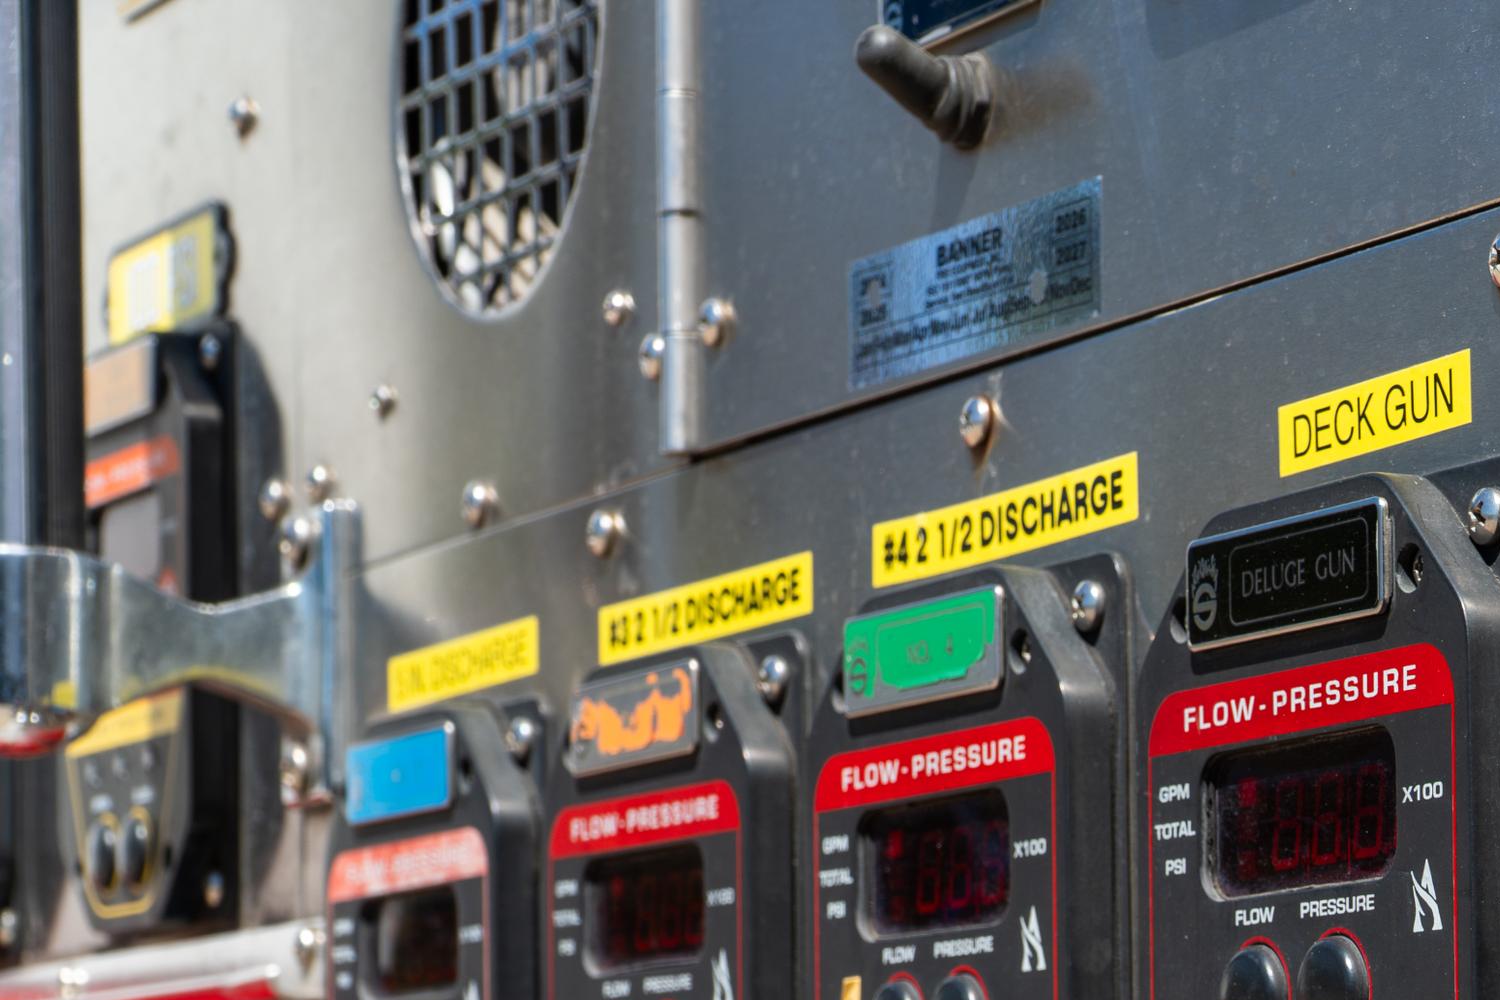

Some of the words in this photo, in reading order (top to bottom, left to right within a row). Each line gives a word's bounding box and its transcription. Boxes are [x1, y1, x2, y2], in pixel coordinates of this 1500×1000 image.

[936, 226, 1002, 267] BANNER
[1293, 391, 1376, 459] DECK
[1385, 368, 1454, 431] GUN
[884, 530, 909, 570] #4
[916, 527, 928, 564] 2
[939, 515, 973, 559] 1/2
[980, 469, 1124, 547] DISCHARGE
[1241, 553, 1307, 599] DELUGE
[1314, 546, 1357, 581] GUN
[685, 568, 800, 630] DISCHARGE
[1158, 783, 1191, 803] GPM
[1402, 781, 1444, 804] X100
[1154, 819, 1196, 842] TOTAL
[821, 834, 850, 856] GPM
[1013, 837, 1048, 859] X100
[819, 867, 854, 888] TOTAL
[1165, 857, 1187, 877] PSI
[826, 901, 847, 920] PSI
[1234, 905, 1275, 927] FLOW
[1299, 893, 1376, 919] PRESSURE
[882, 945, 916, 965] FLOW
[932, 935, 995, 960] PRESSURE
